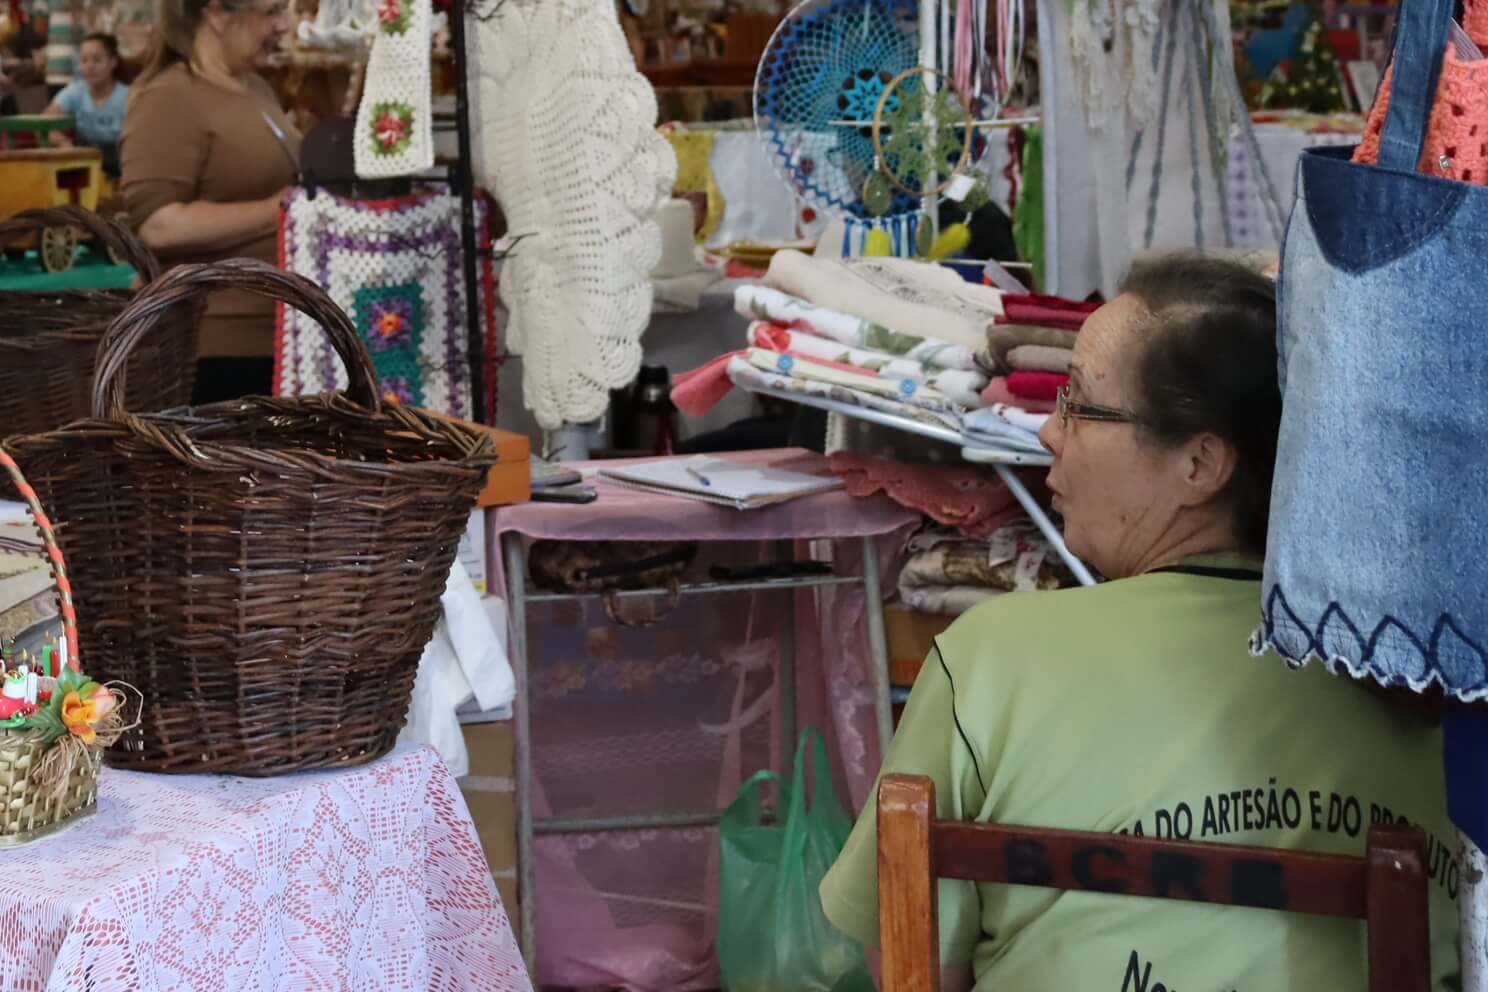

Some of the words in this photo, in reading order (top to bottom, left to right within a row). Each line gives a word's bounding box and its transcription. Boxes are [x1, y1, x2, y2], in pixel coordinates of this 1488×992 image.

[1155, 802, 1193, 841] DO
[1201, 777, 1301, 837] ARTESÃO
[1309, 791, 1321, 831] E
[1328, 792, 1362, 838] DO
